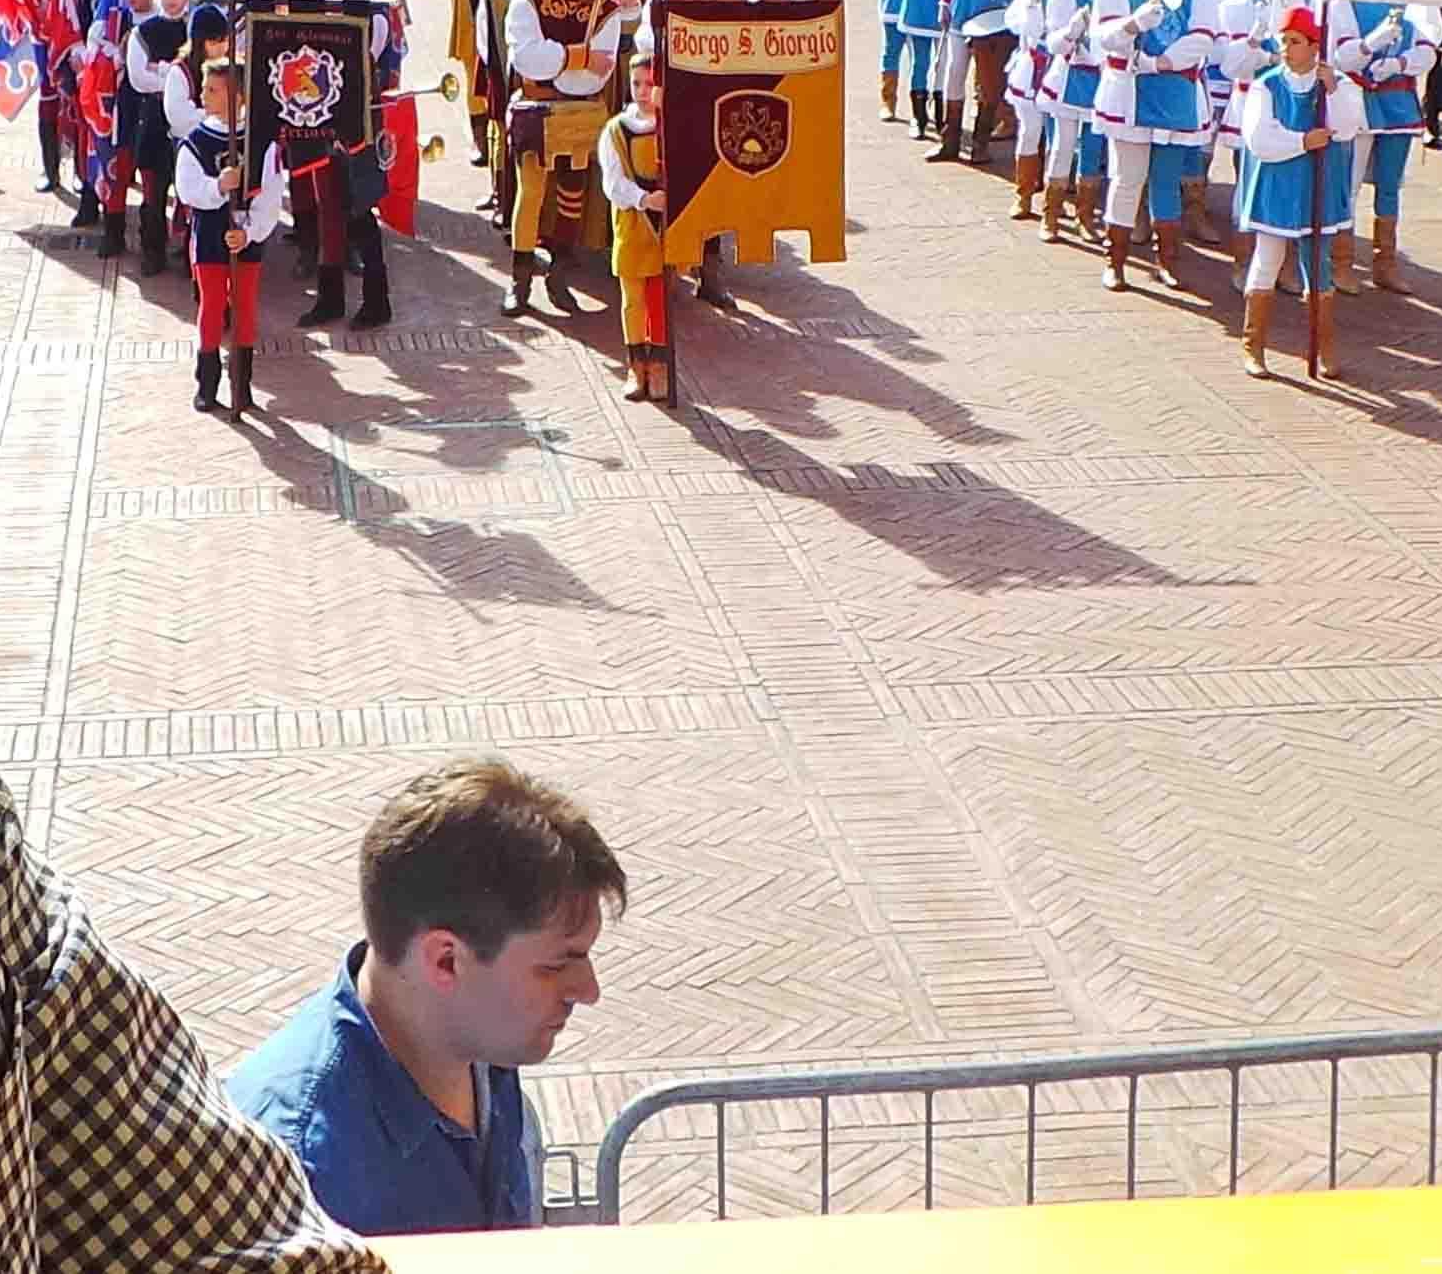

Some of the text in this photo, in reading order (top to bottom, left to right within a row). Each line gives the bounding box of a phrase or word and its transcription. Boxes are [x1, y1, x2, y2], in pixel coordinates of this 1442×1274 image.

[672, 25, 838, 64] Borgo S. Giorgio
